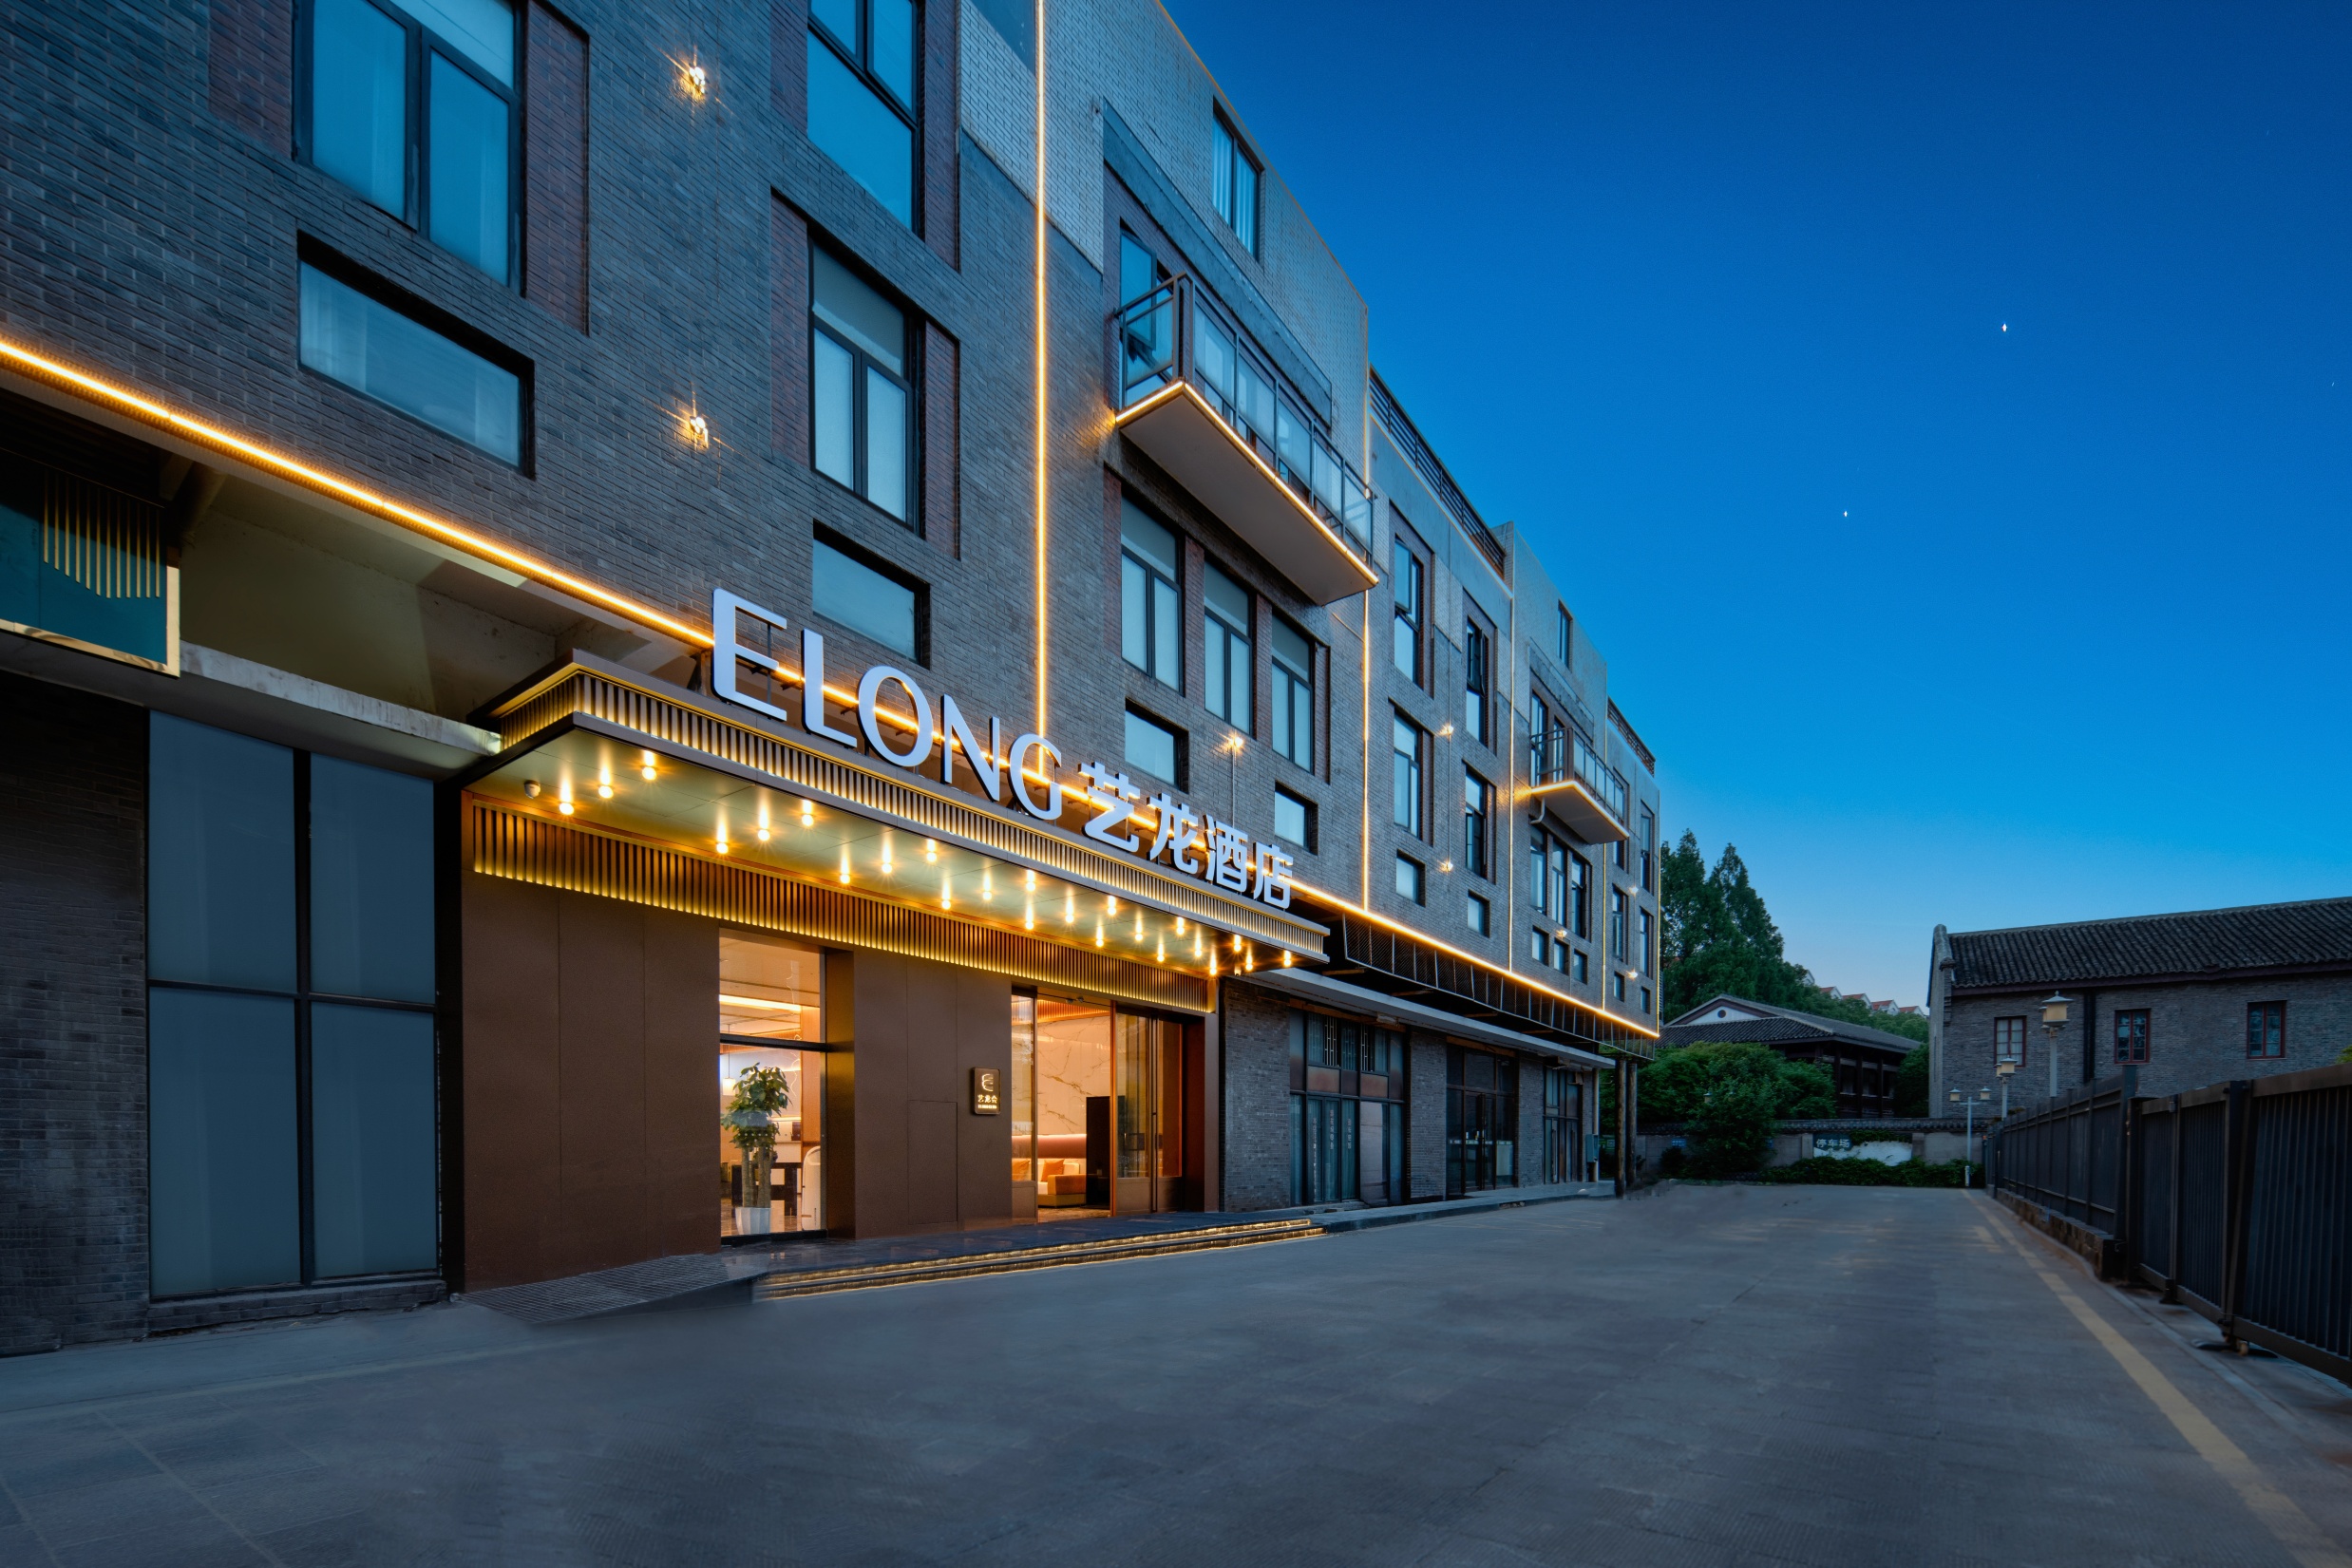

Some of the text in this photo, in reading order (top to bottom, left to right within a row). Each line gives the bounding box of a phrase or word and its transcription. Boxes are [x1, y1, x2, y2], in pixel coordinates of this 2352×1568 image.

[712, 588, 1294, 910] ELONG 艺龙酒店
[1816, 1138, 1849, 1148] 停车场
